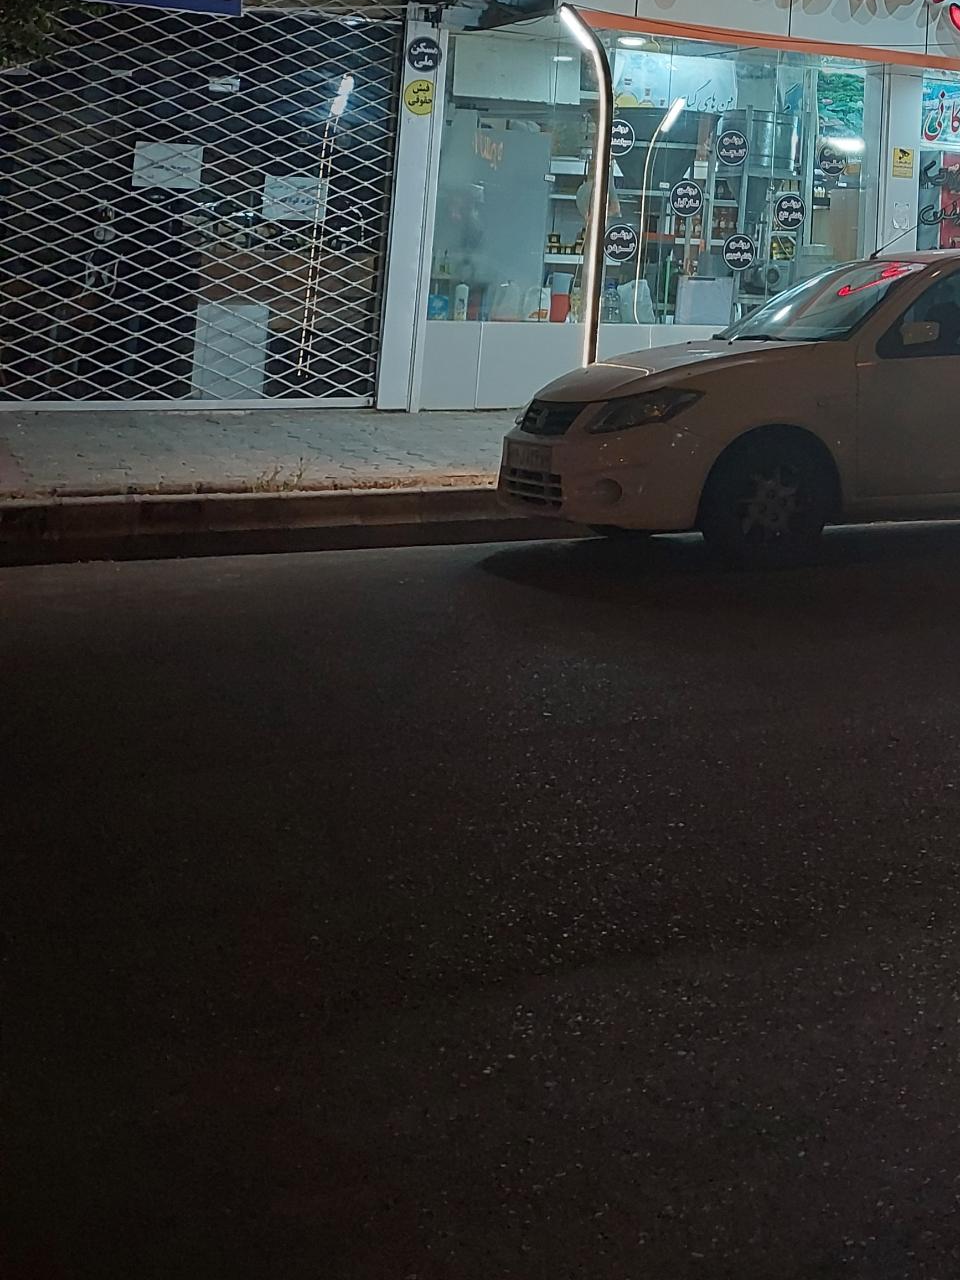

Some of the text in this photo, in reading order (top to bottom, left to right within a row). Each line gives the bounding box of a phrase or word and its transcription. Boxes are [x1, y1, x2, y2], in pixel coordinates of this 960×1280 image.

[411, 43, 438, 55] مسکن
[414, 55, 434, 68] ملی
[412, 83, 430, 94] فیش
[677, 186, 697, 196] روغن
[781, 199, 801, 209] روغن
[610, 230, 632, 240] روغن
[729, 239, 750, 250] روغن
